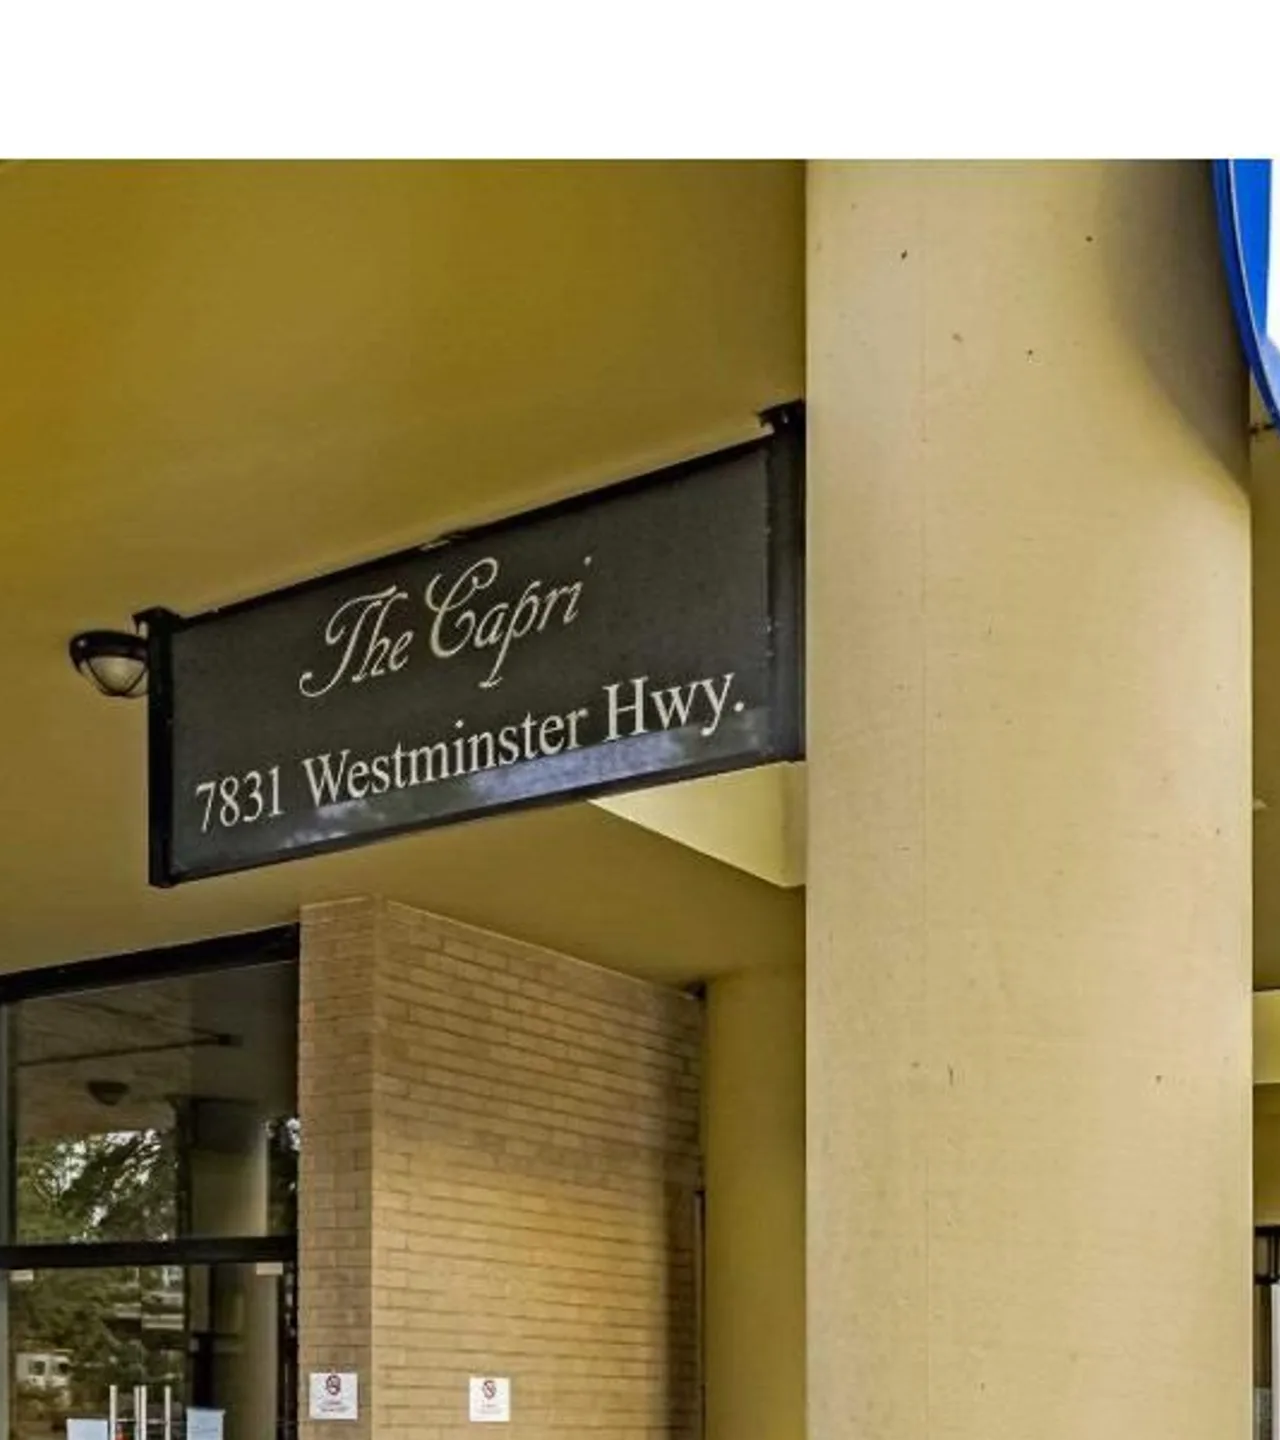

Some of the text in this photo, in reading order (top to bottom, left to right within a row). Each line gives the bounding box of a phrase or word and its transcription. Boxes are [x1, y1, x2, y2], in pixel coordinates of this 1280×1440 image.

[298, 556, 592, 698] The Capri
[195, 672, 745, 834] 7831 Westminster Hwy.
